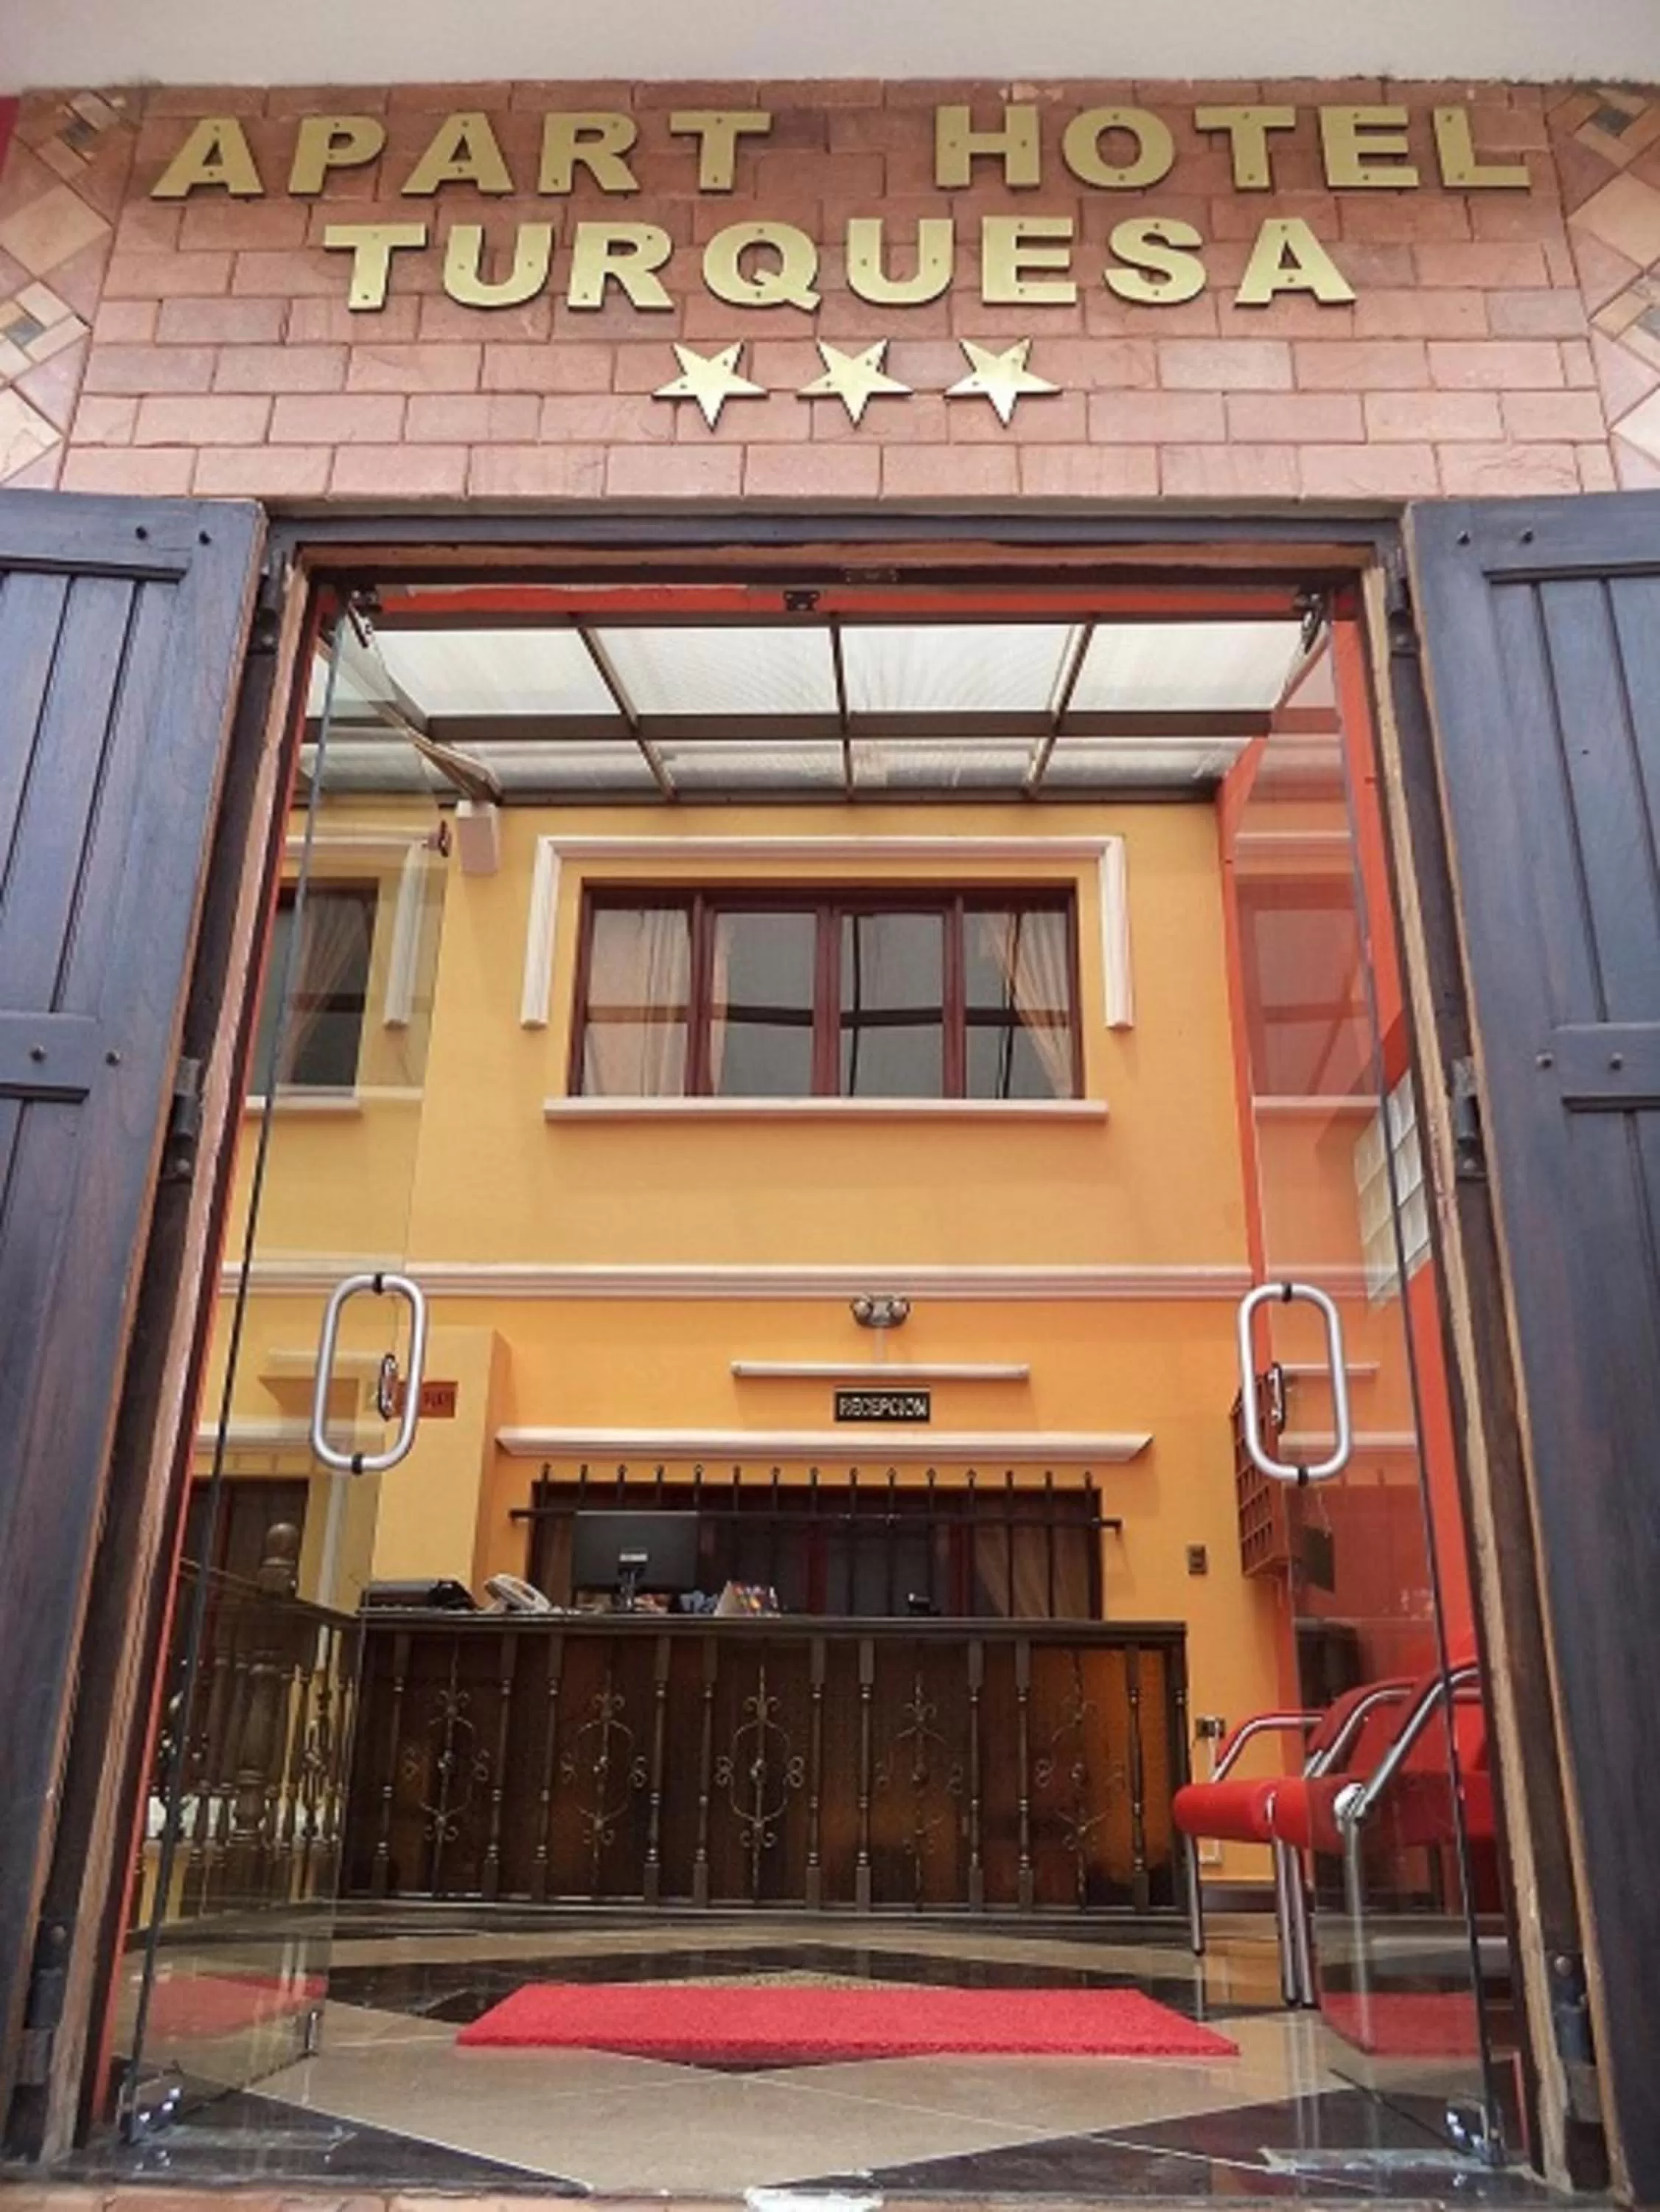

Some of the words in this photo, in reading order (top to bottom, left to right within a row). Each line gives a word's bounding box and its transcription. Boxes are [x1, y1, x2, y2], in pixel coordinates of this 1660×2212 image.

[150, 111, 773, 198] APART
[934, 105, 1531, 190] HOTEL
[323, 216, 1356, 311] TURQUESA
